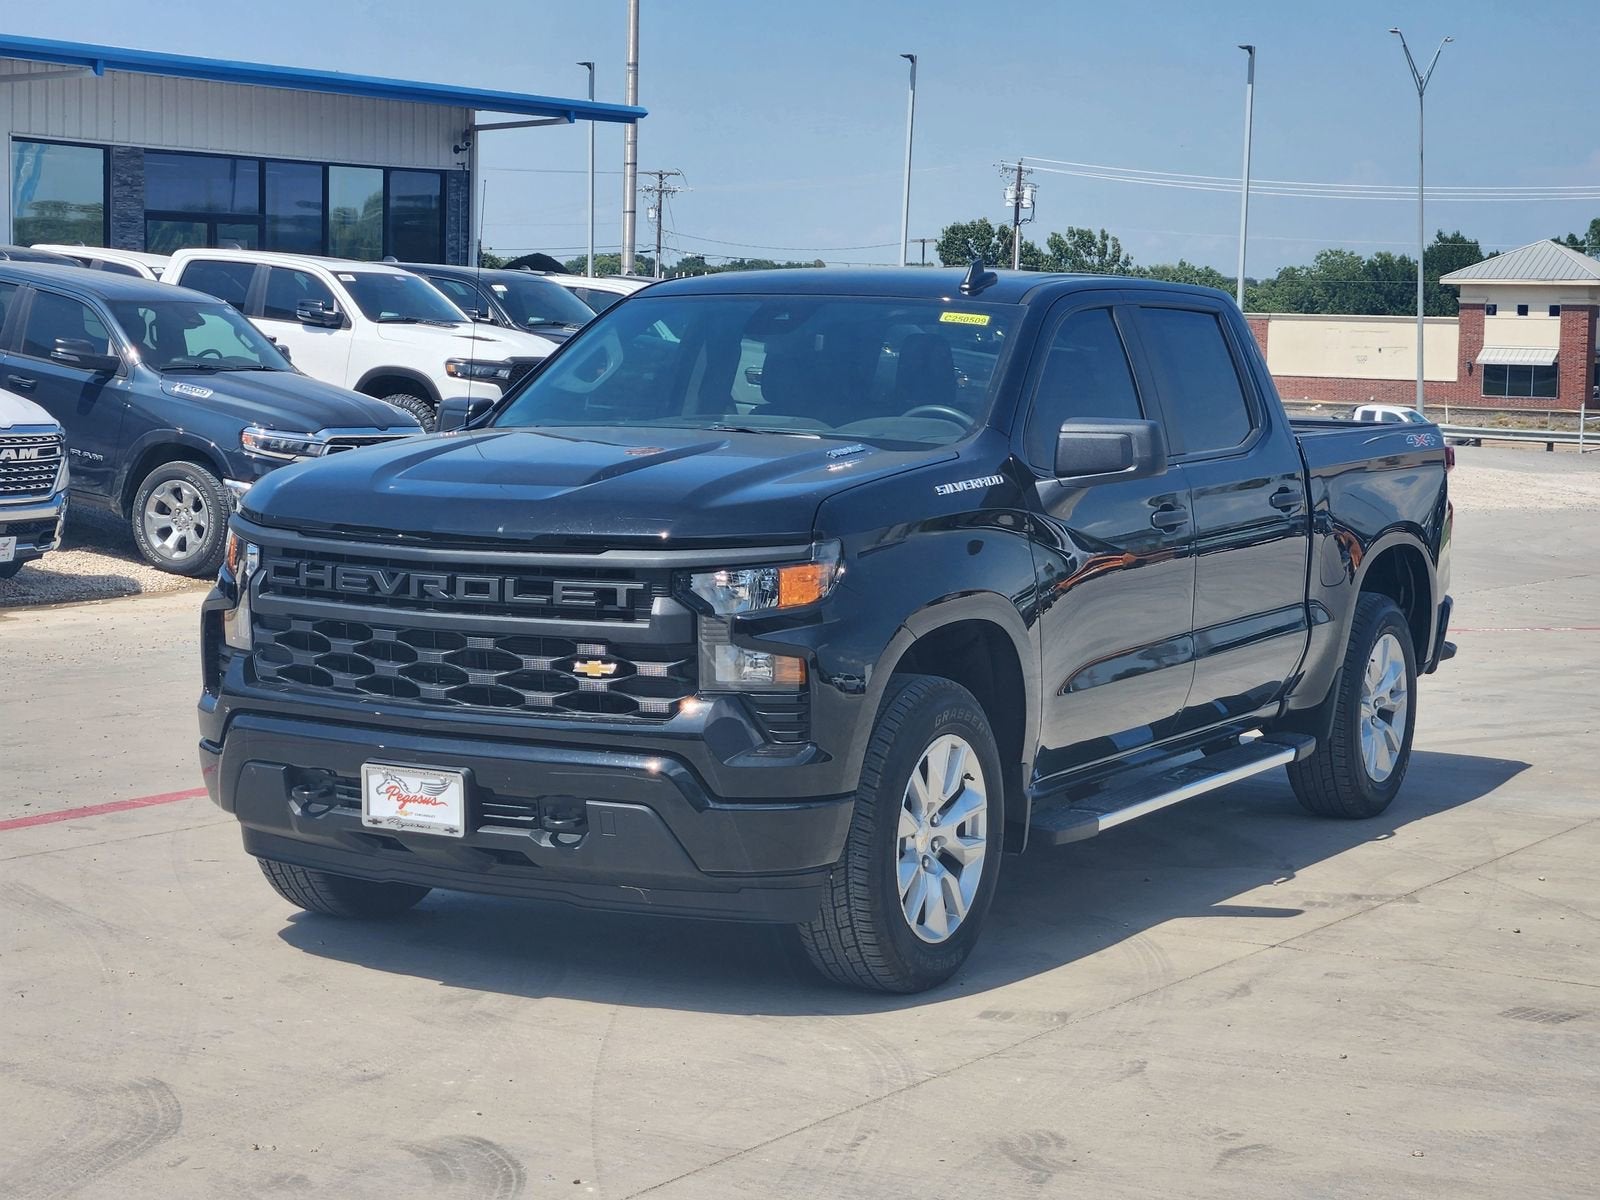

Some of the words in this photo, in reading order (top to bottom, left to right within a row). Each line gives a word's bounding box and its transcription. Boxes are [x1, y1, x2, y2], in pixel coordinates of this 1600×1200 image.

[0, 448, 38, 460] AM
[70, 448, 103, 461] RAM
[935, 475, 1004, 495] SILVERADO
[266, 560, 644, 607] CHEVROLET
[386, 786, 448, 809] Pegasus
